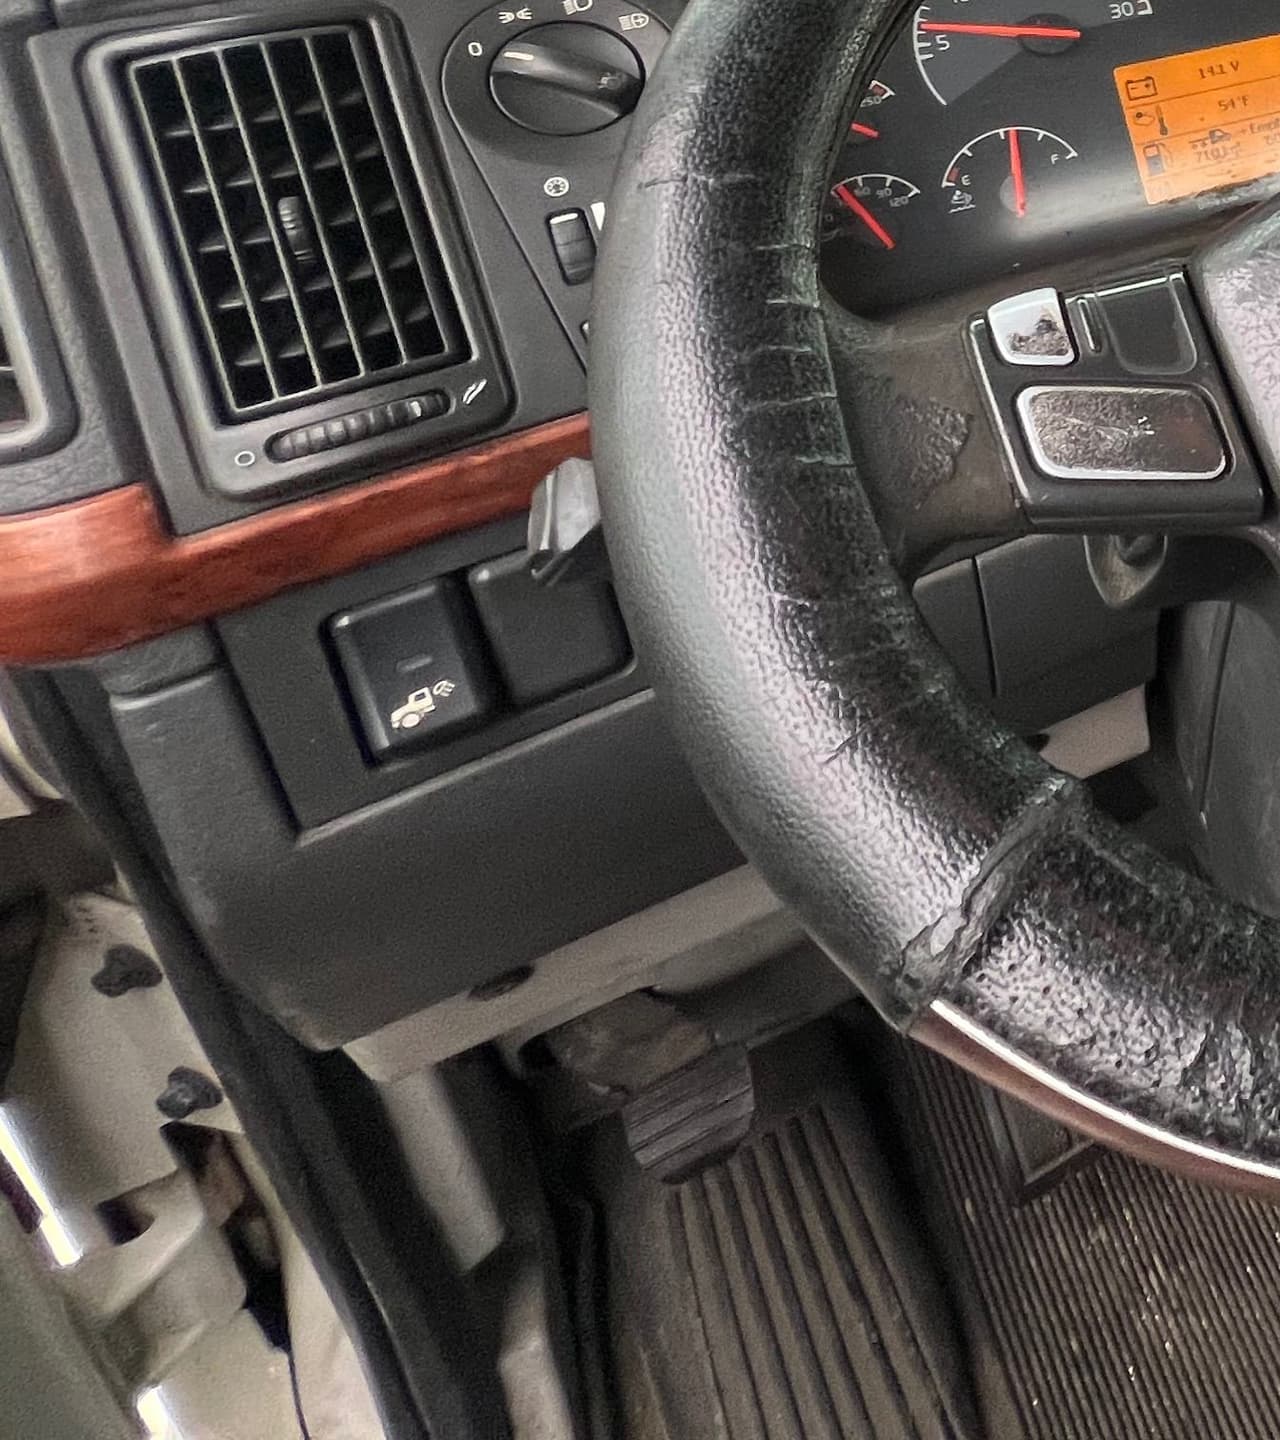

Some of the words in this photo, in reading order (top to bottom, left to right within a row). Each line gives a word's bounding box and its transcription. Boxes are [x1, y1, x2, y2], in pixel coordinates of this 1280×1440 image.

[1109, 2, 1134, 19] 30
[935, 35, 950, 51] 5
[1051, 154, 1060, 165] F
[961, 175, 972, 186] E
[876, 188, 892, 199] 90
[889, 196, 909, 208] 120
